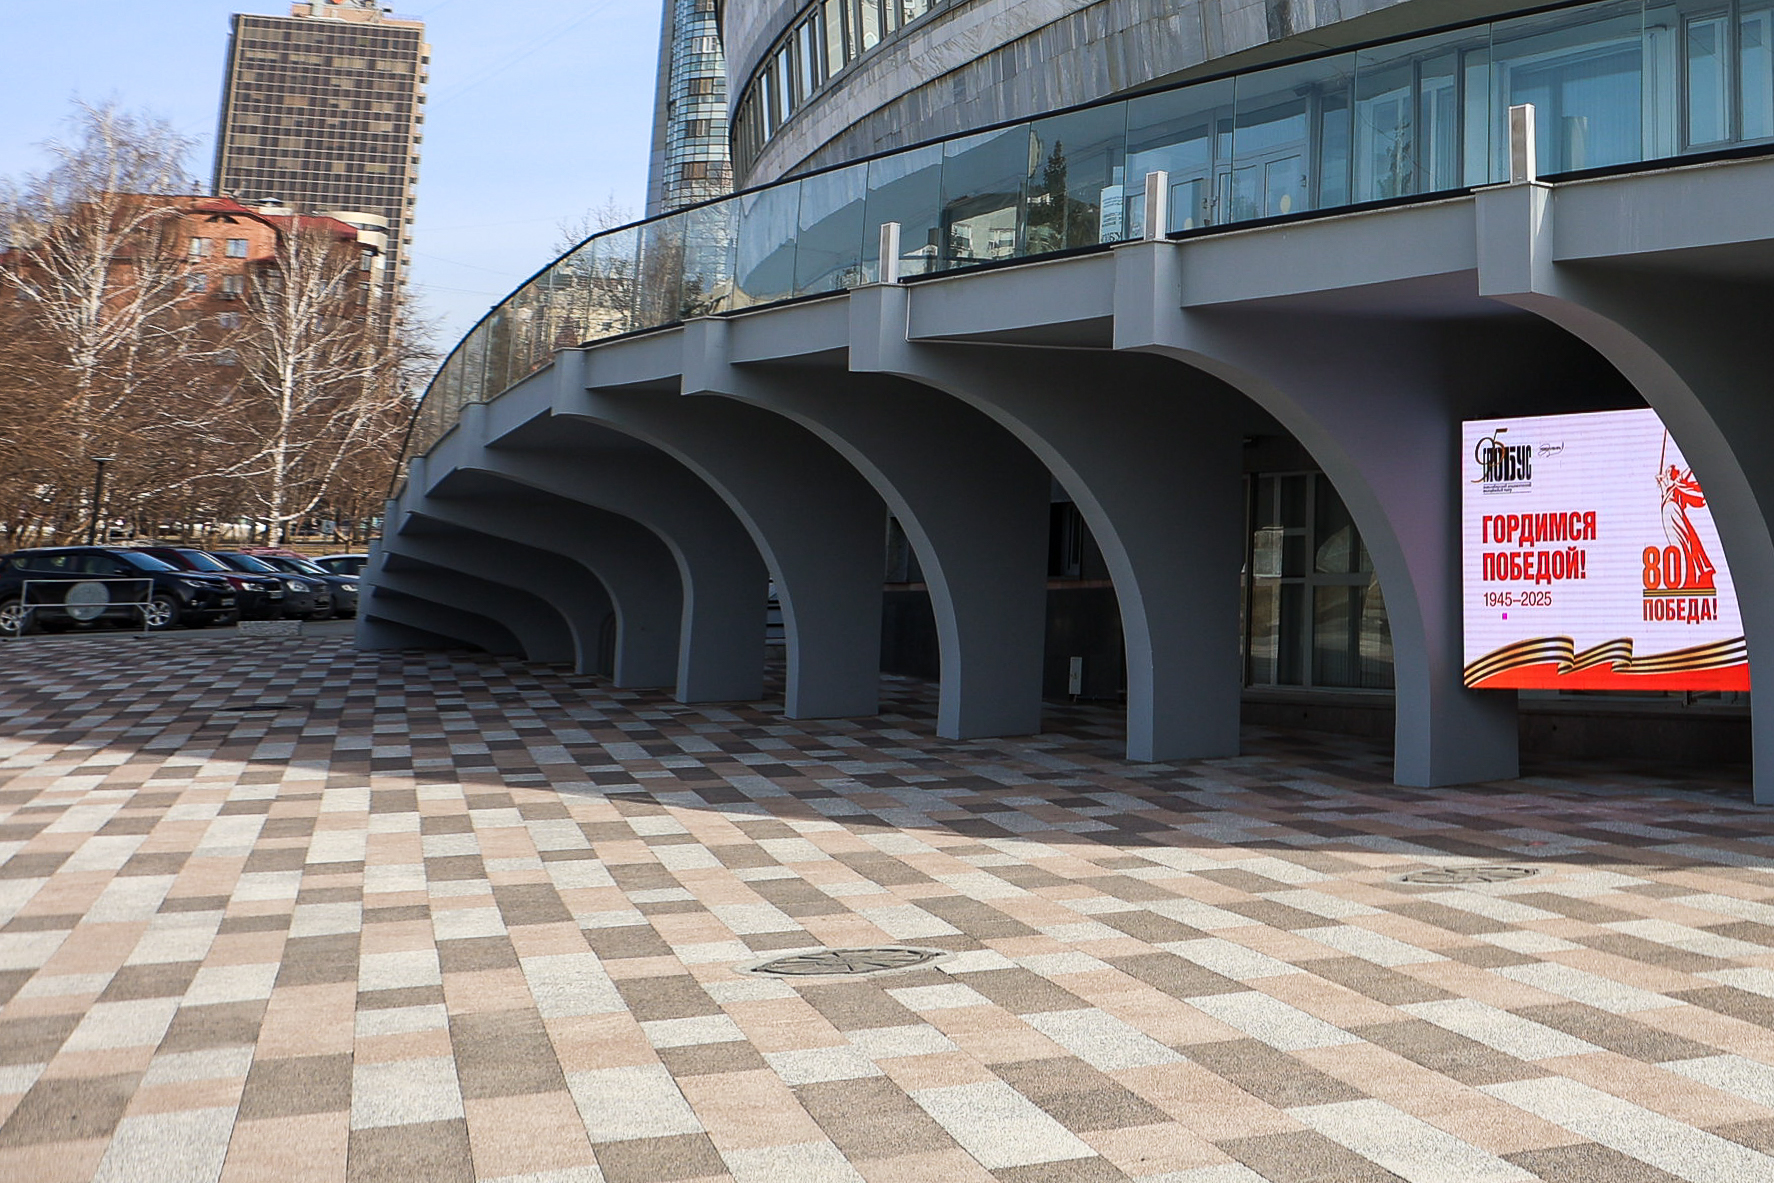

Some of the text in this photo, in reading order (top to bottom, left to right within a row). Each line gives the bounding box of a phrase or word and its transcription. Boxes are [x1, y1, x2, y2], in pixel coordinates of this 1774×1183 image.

[1482, 511, 1596, 548] ГОРДИМСЯ
[1482, 546, 1586, 585] ПОБЕДОЙ!
[1642, 545, 1682, 589] 80
[1643, 598, 1718, 624] ПОБЕДА!
